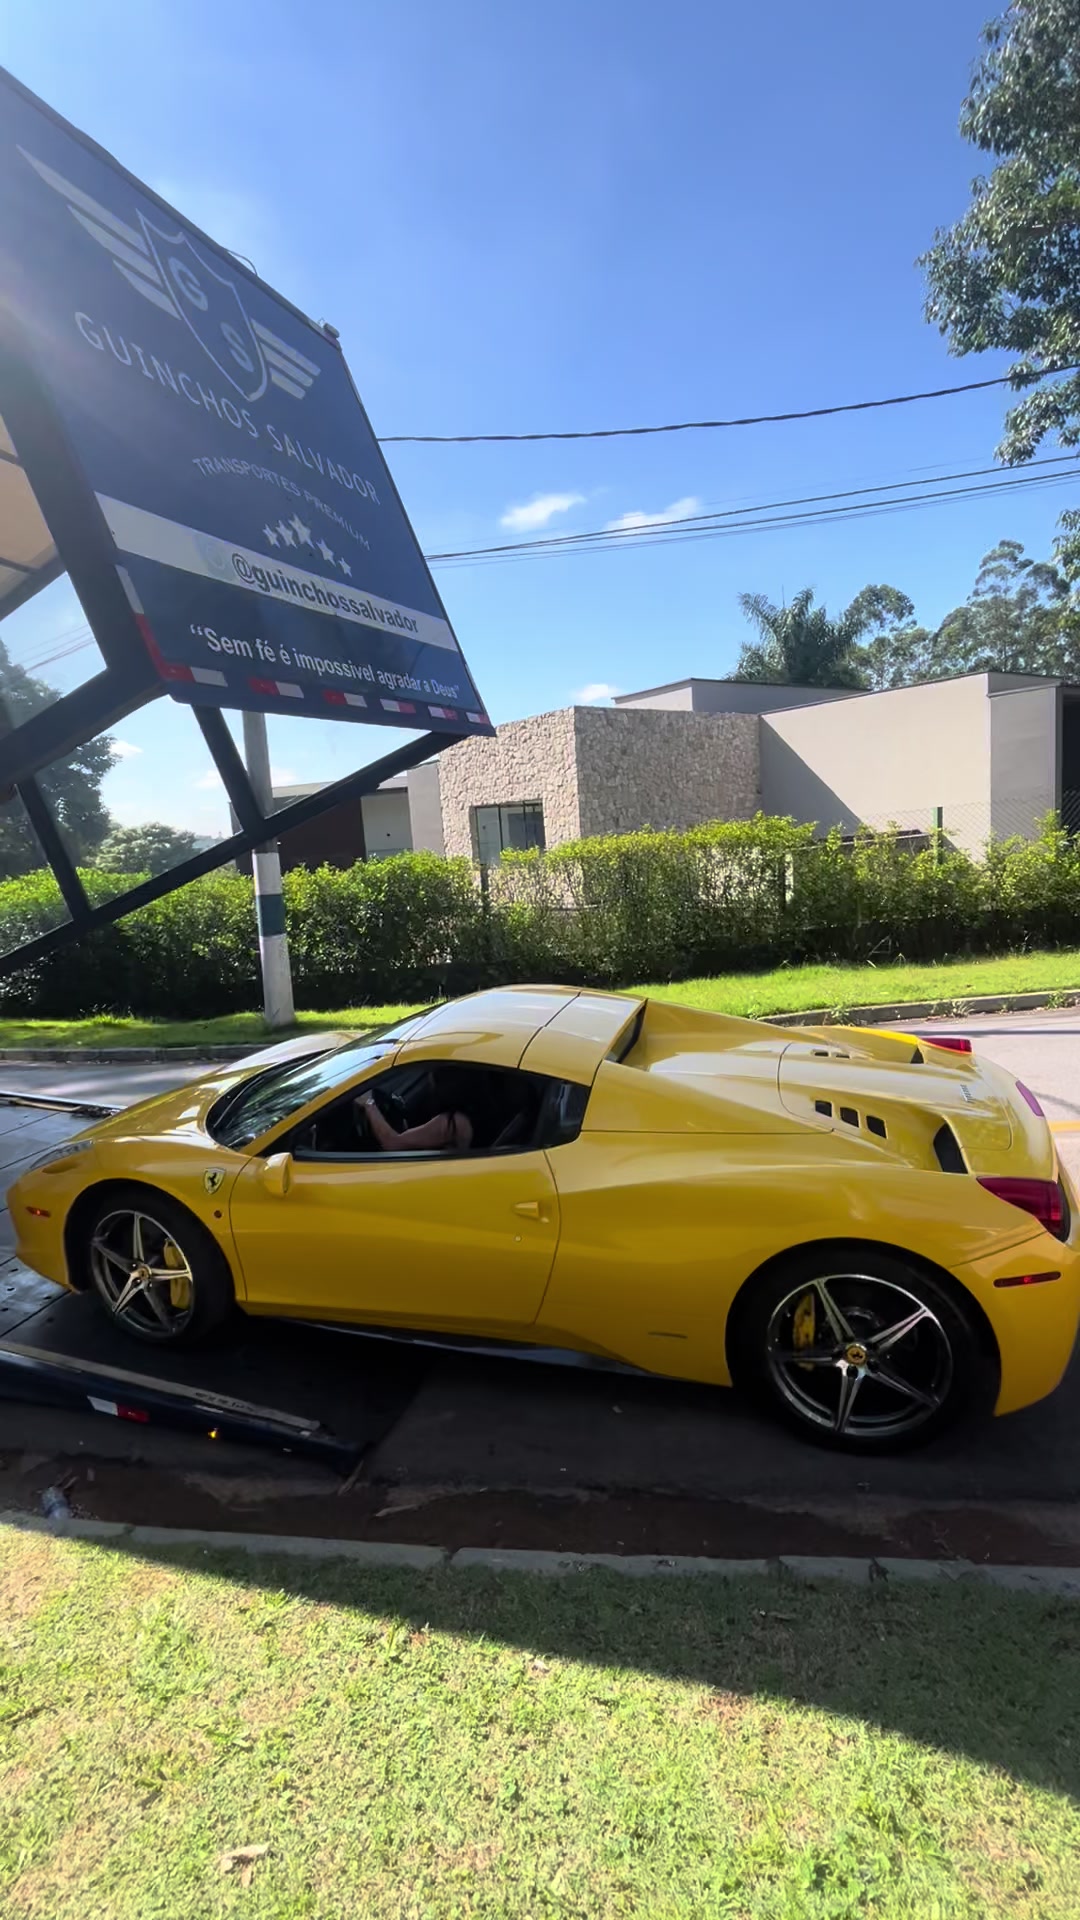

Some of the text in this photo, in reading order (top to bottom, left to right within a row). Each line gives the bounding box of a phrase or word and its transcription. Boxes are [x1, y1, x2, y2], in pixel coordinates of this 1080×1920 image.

[75, 312, 380, 505] GUINCHOS SALVADOR
[192, 457, 370, 551] TRANSPORTES PREMIUM
[231, 553, 418, 633] @guinchossalvador
[255, 638, 276, 662] fé
[279, 644, 291, 665] é
[377, 669, 421, 690] agradar
[423, 680, 431, 692] a
